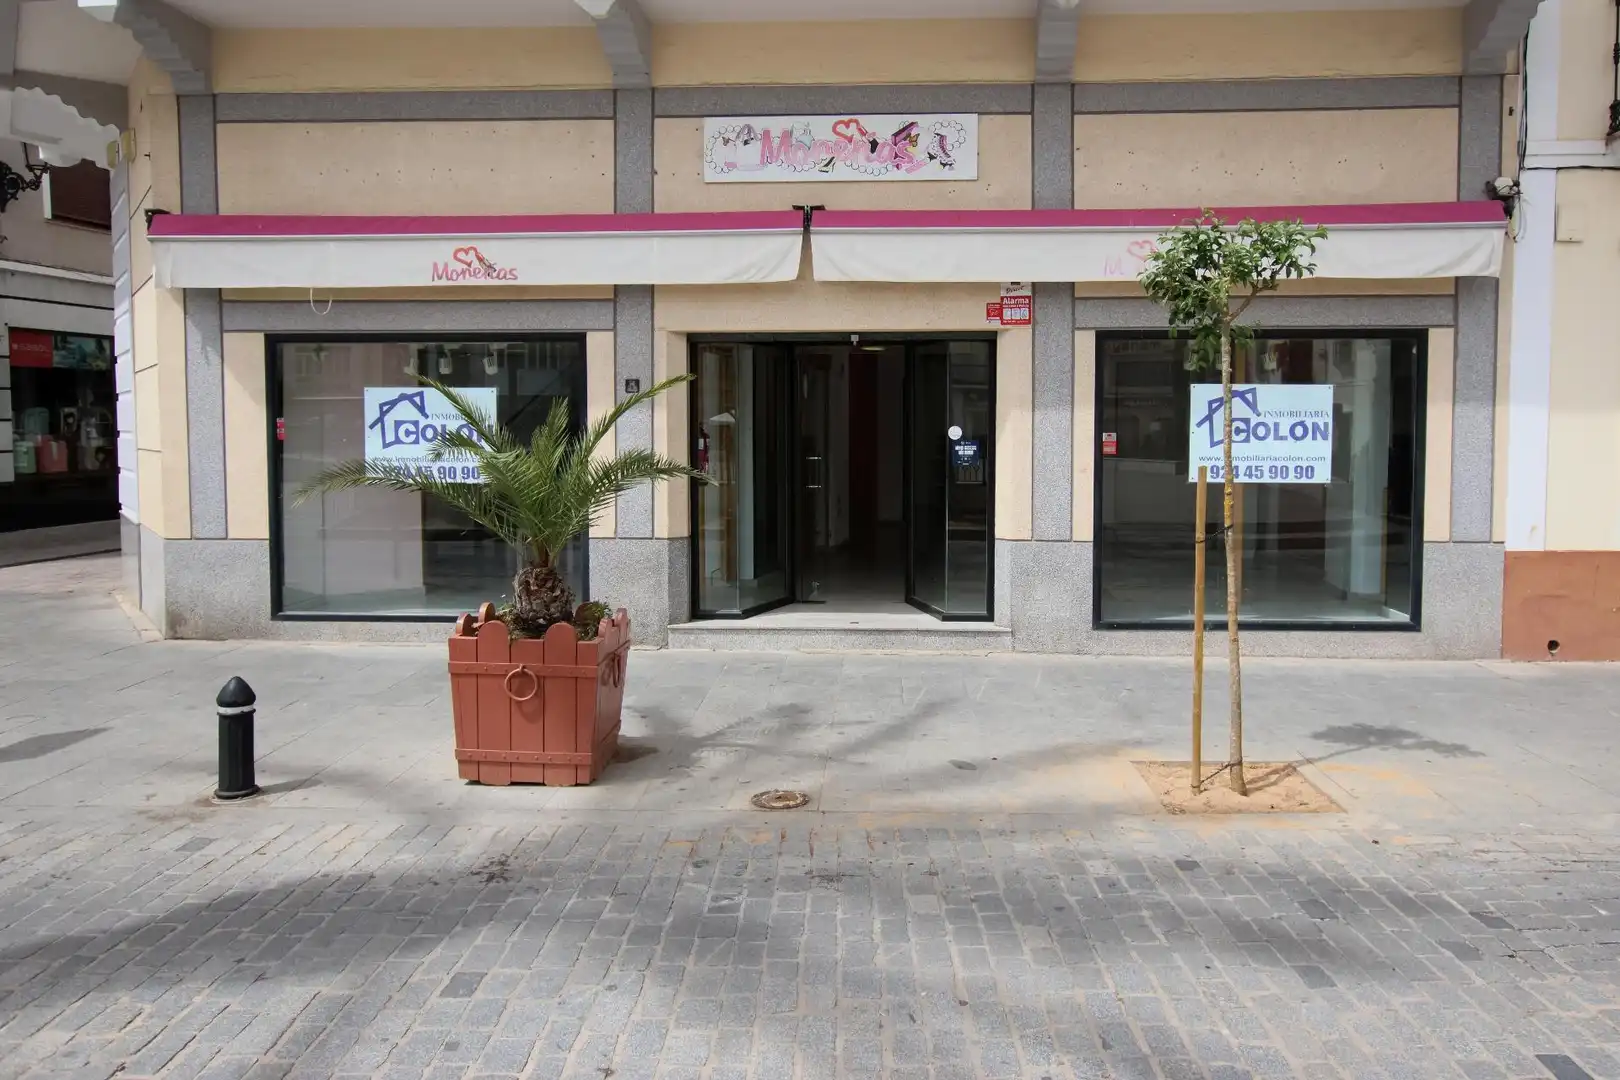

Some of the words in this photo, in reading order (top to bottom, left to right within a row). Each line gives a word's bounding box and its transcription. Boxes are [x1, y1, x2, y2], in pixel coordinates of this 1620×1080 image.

[1003, 297, 1029, 305] Alarma
[1263, 409, 1330, 418] INMOBILIARIA
[396, 421, 494, 444] COL
[1198, 454, 1326, 462] www.mobiliariacolon.com
[437, 466, 457, 480] 90
[461, 466, 481, 480] 90
[1243, 464, 1264, 480] 45
[1268, 464, 1290, 480] 90
[1293, 464, 1315, 480] 90
